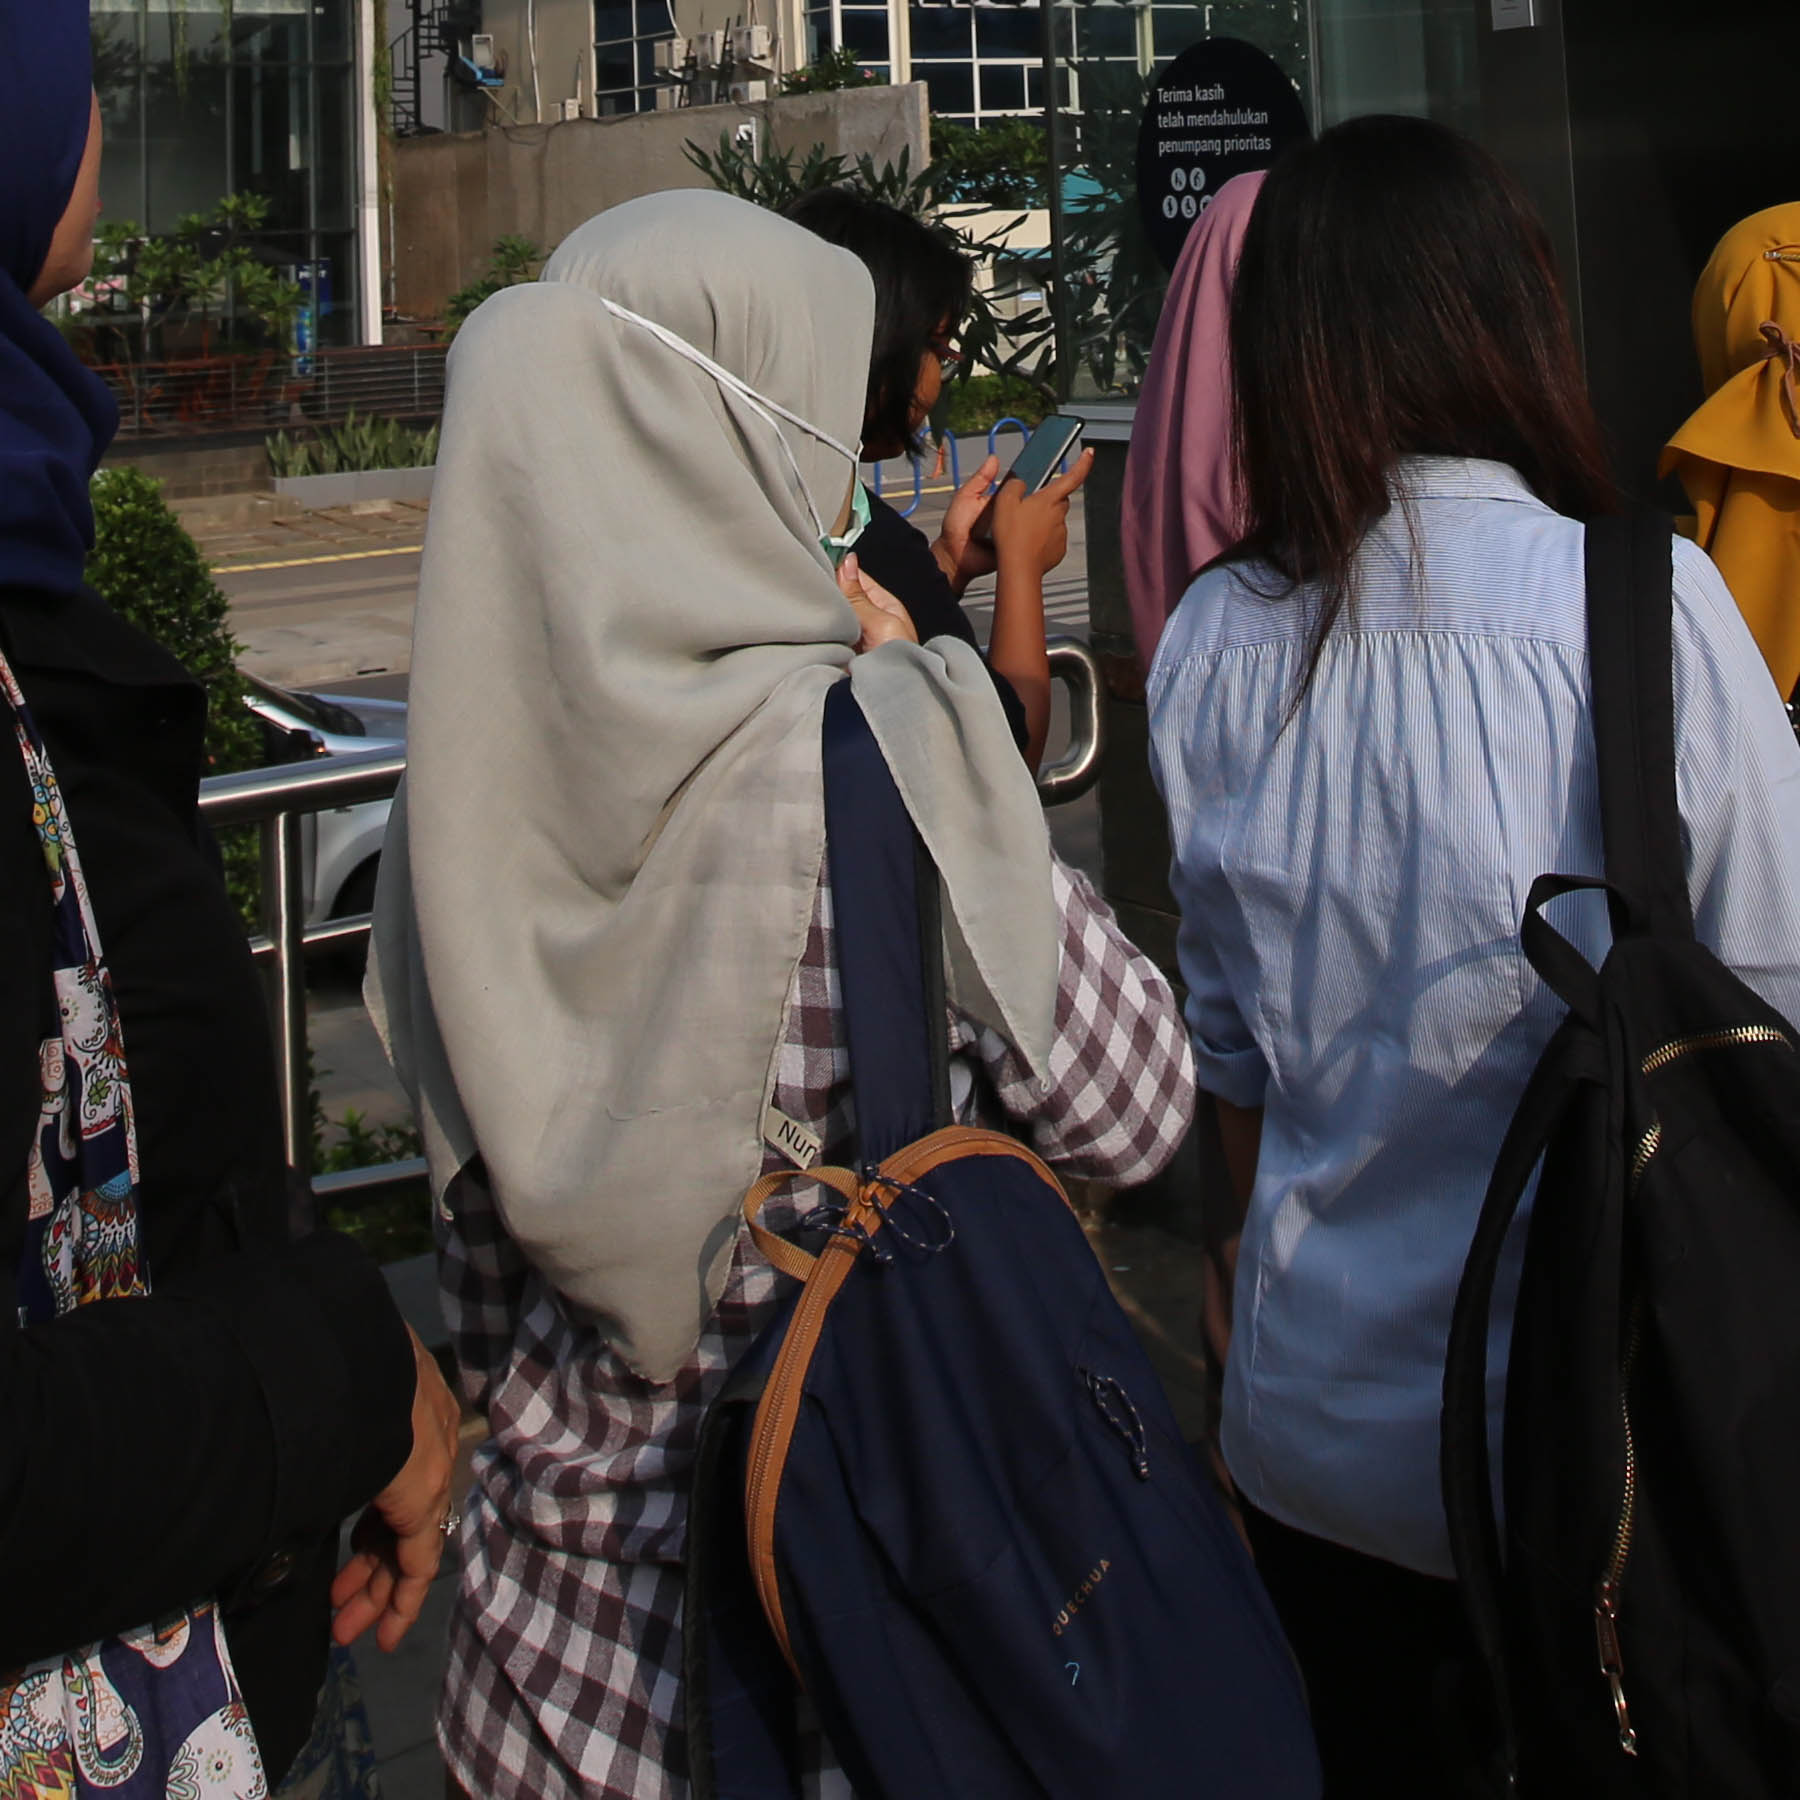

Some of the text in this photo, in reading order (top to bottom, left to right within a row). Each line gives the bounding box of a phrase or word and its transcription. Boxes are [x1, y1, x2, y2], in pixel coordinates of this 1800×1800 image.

[1157, 84, 1224, 103] Terima kasih
[1158, 108, 1268, 128] telah mendahulukan
[1159, 135, 1271, 157] penumpang prioritas
[1052, 1559, 1111, 1635] QUECHUA
